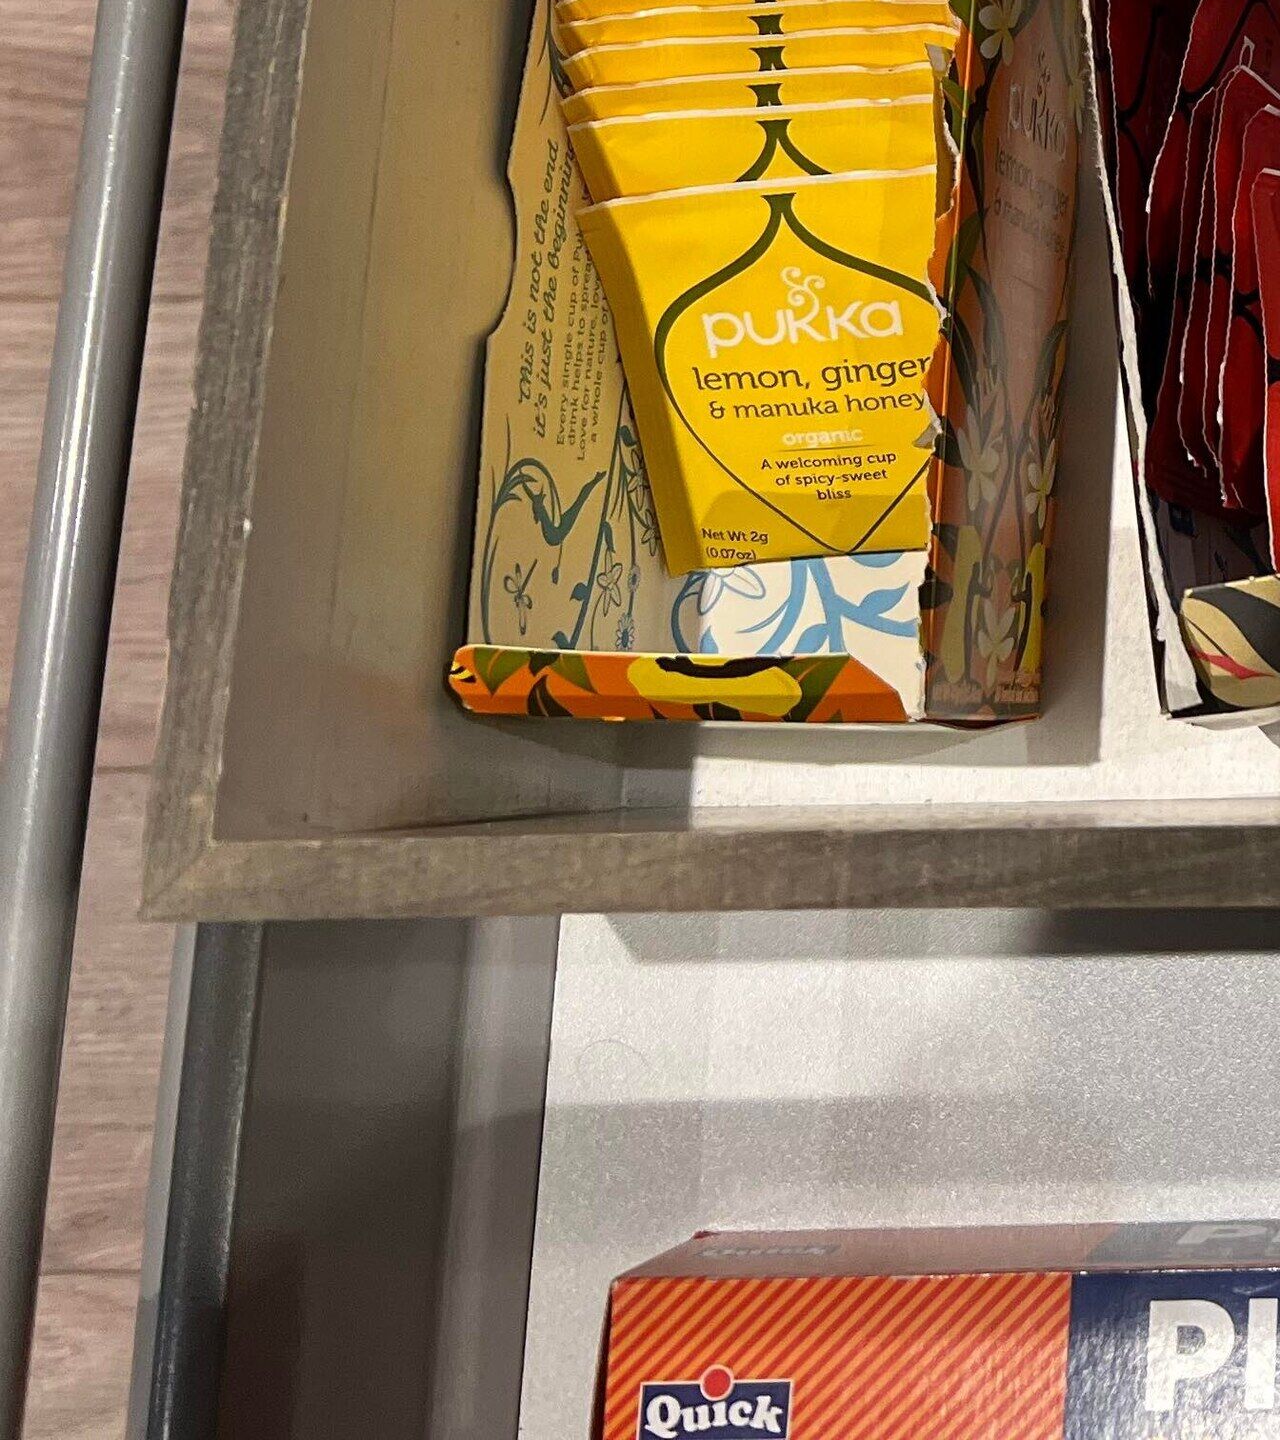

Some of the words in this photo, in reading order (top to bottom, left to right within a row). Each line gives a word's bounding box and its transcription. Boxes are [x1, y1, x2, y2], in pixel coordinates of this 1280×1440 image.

[544, 138, 559, 193] end
[534, 199, 549, 245] the
[529, 251, 543, 302] not
[572, 266, 579, 286] of
[543, 276, 558, 322] the
[568, 292, 578, 327] cup
[602, 306, 608, 325] of
[702, 266, 904, 360] pukka
[523, 309, 537, 334] is
[577, 317, 586, 336] to
[536, 328, 552, 391] just
[562, 331, 573, 389] single
[572, 341, 584, 391] helps
[598, 330, 607, 365] cup
[519, 342, 535, 404] This
[692, 366, 811, 391] lemon,
[821, 356, 931, 392] ginger
[533, 393, 548, 438] it's
[557, 396, 569, 445] Every
[581, 387, 591, 411] for
[592, 371, 603, 427] whole
[709, 401, 725, 419] &
[733, 398, 838, 419] manuka
[844, 392, 925, 412] honey
[568, 397, 579, 446] drink
[577, 417, 588, 461] Love
[781, 429, 864, 448] organic
[760, 458, 772, 471] A
[775, 453, 862, 470] welcoming
[867, 451, 897, 466] cup
[775, 474, 791, 486] of
[794, 469, 888, 487] spicy-sweet
[816, 488, 852, 501] bliss
[701, 528, 725, 542] Net
[731, 529, 748, 543] Wt
[750, 530, 769, 545] 2g
[643, 1394, 783, 1439] Quick
